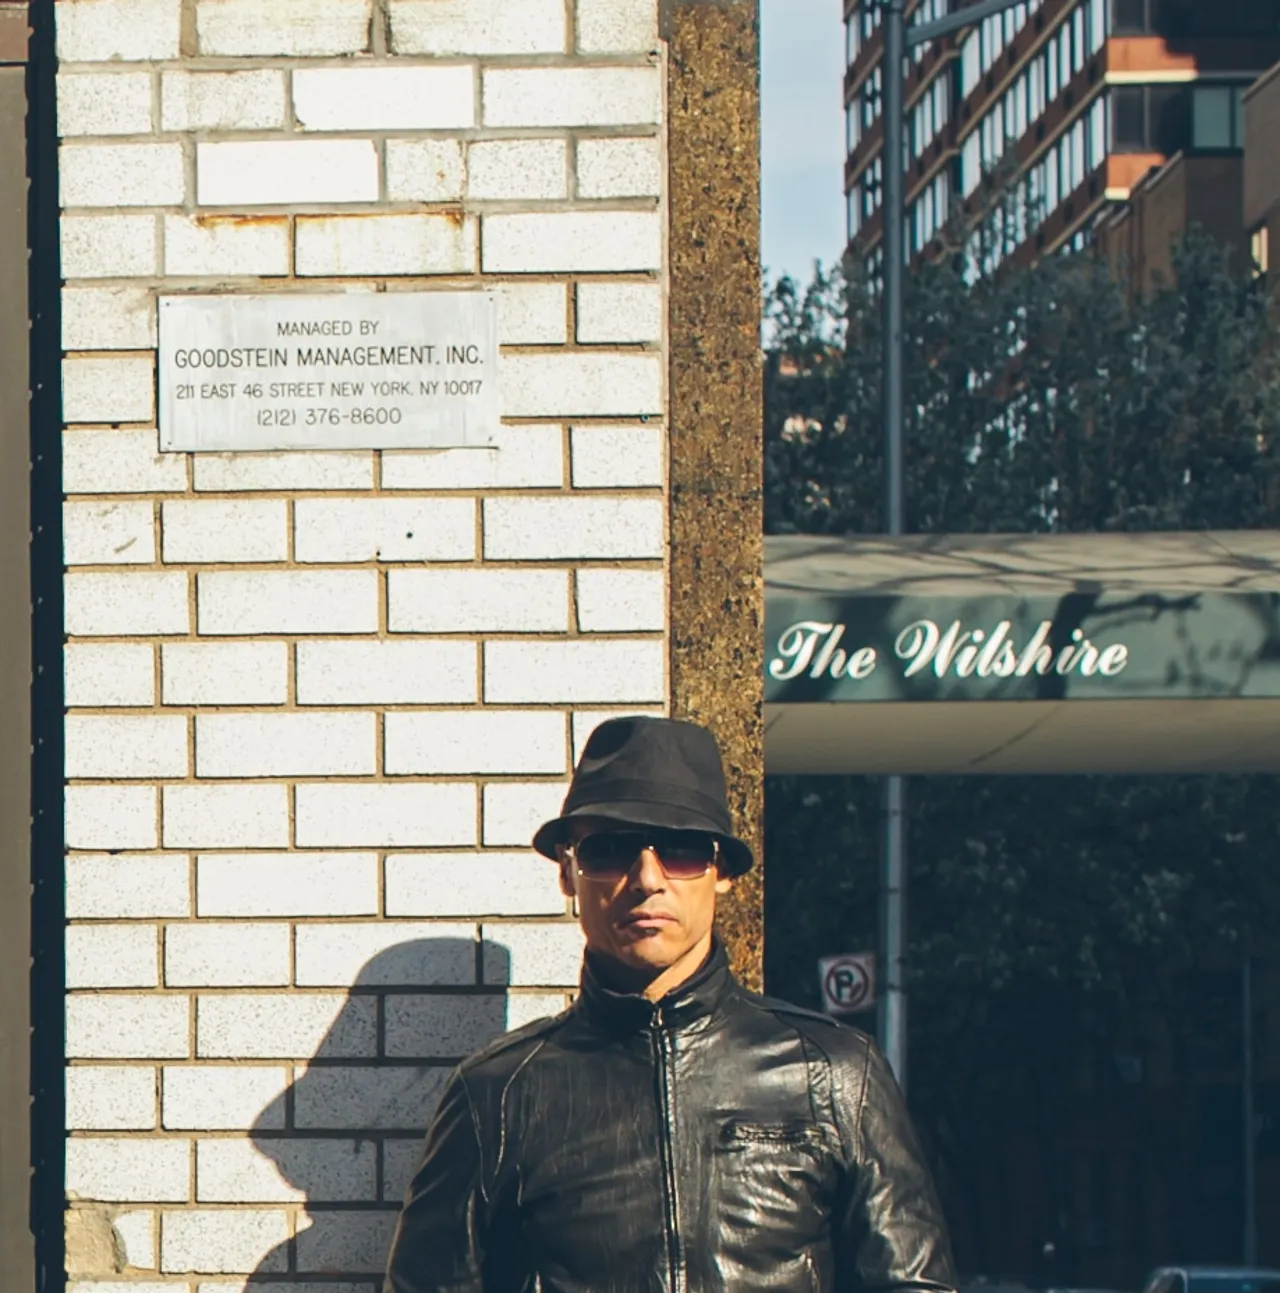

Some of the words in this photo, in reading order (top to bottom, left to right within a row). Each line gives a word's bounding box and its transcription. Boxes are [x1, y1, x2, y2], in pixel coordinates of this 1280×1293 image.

[277, 321, 352, 336] MANAGED
[360, 320, 379, 335] BY
[175, 348, 288, 368] GOODSTEIN
[446, 344, 484, 364] INC.
[176, 384, 195, 399] 211
[200, 383, 237, 398] EAST
[242, 383, 263, 397] 46
[269, 382, 325, 397] STREET
[330, 381, 364, 396] NEW
[420, 380, 439, 395] NY
[444, 379, 483, 395] 10017
[257, 408, 297, 426] (212)
[305, 406, 402, 425] 376-8600
[769, 621, 876, 681] The
[894, 619, 1128, 678] Wilshire
